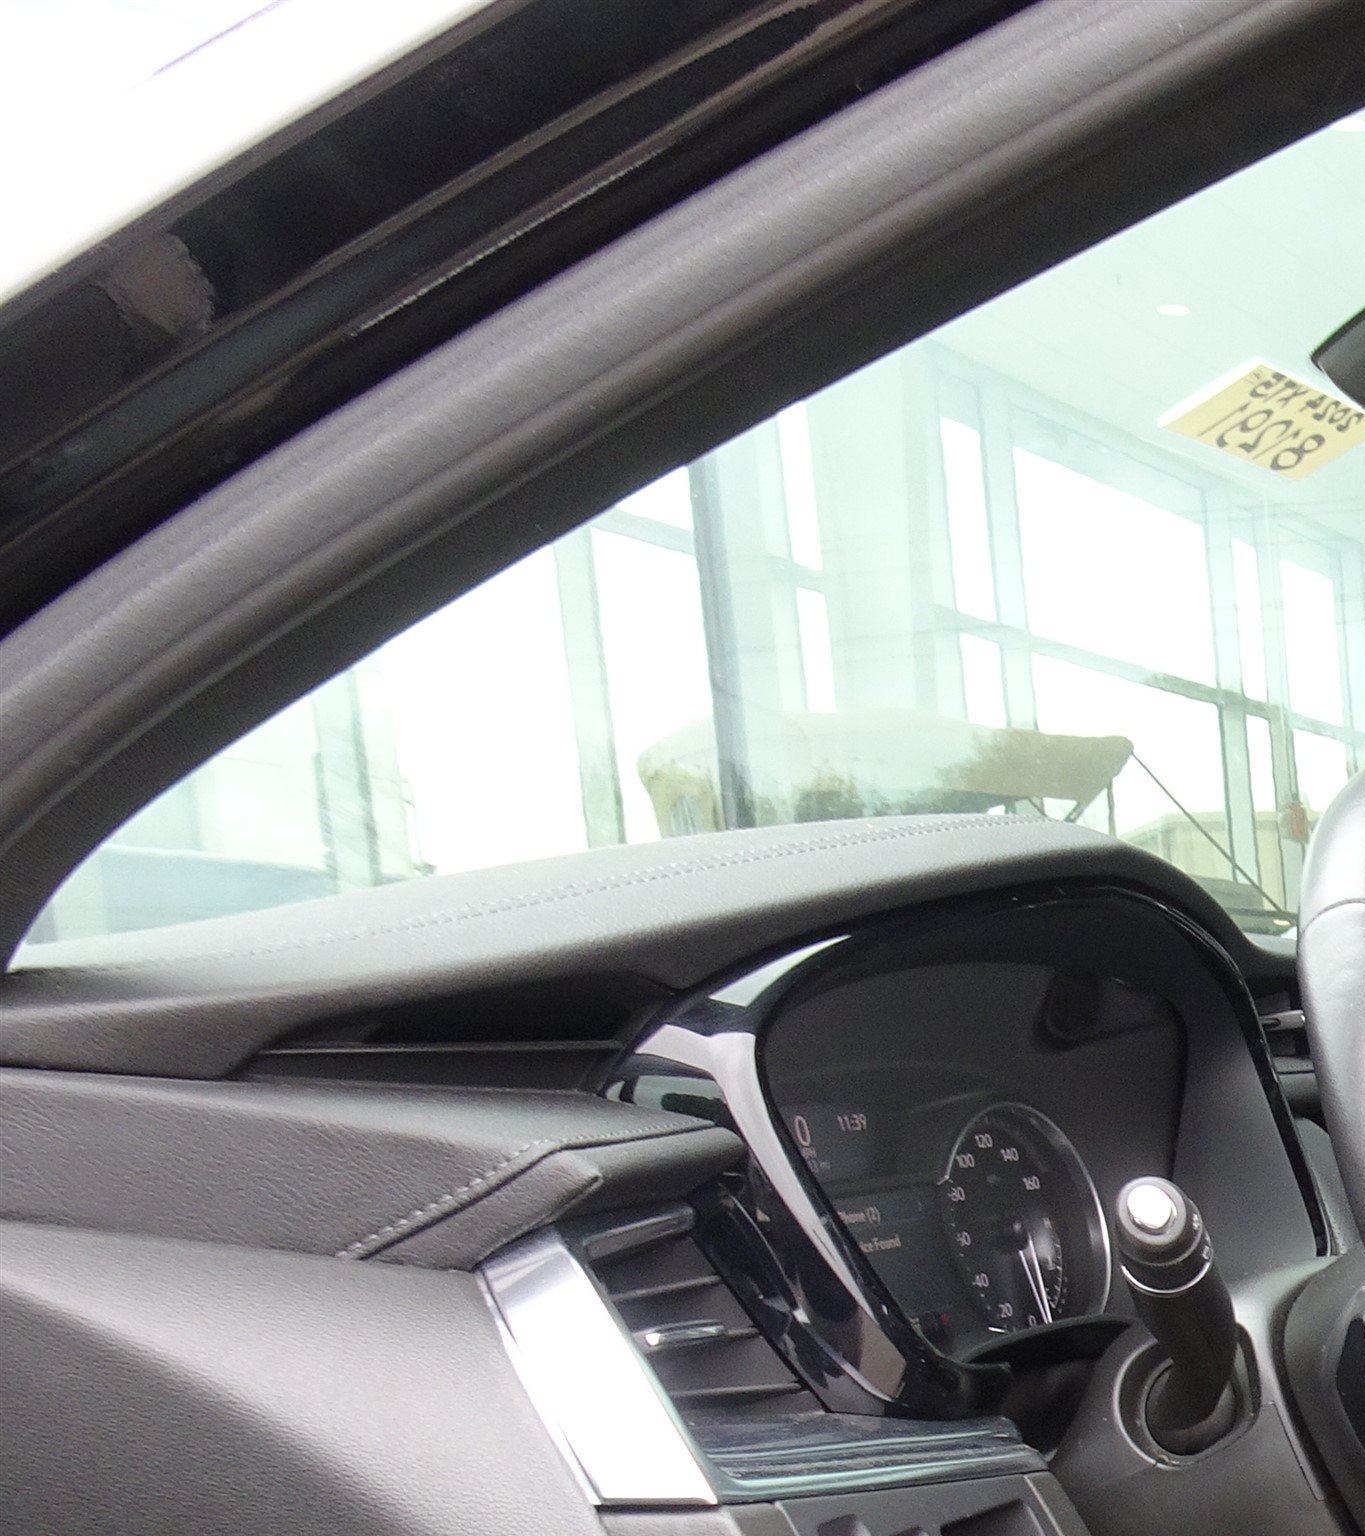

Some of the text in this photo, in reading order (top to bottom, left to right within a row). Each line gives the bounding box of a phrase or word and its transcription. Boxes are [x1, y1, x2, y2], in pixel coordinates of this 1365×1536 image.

[794, 1115, 811, 1147] 0
[974, 1133, 993, 1148] 120
[955, 1153, 976, 1169] 100
[1000, 1147, 1020, 1162] 140
[1021, 1175, 1041, 1191] 160
[973, 1272, 990, 1288] 40
[998, 1302, 1013, 1318] 20
